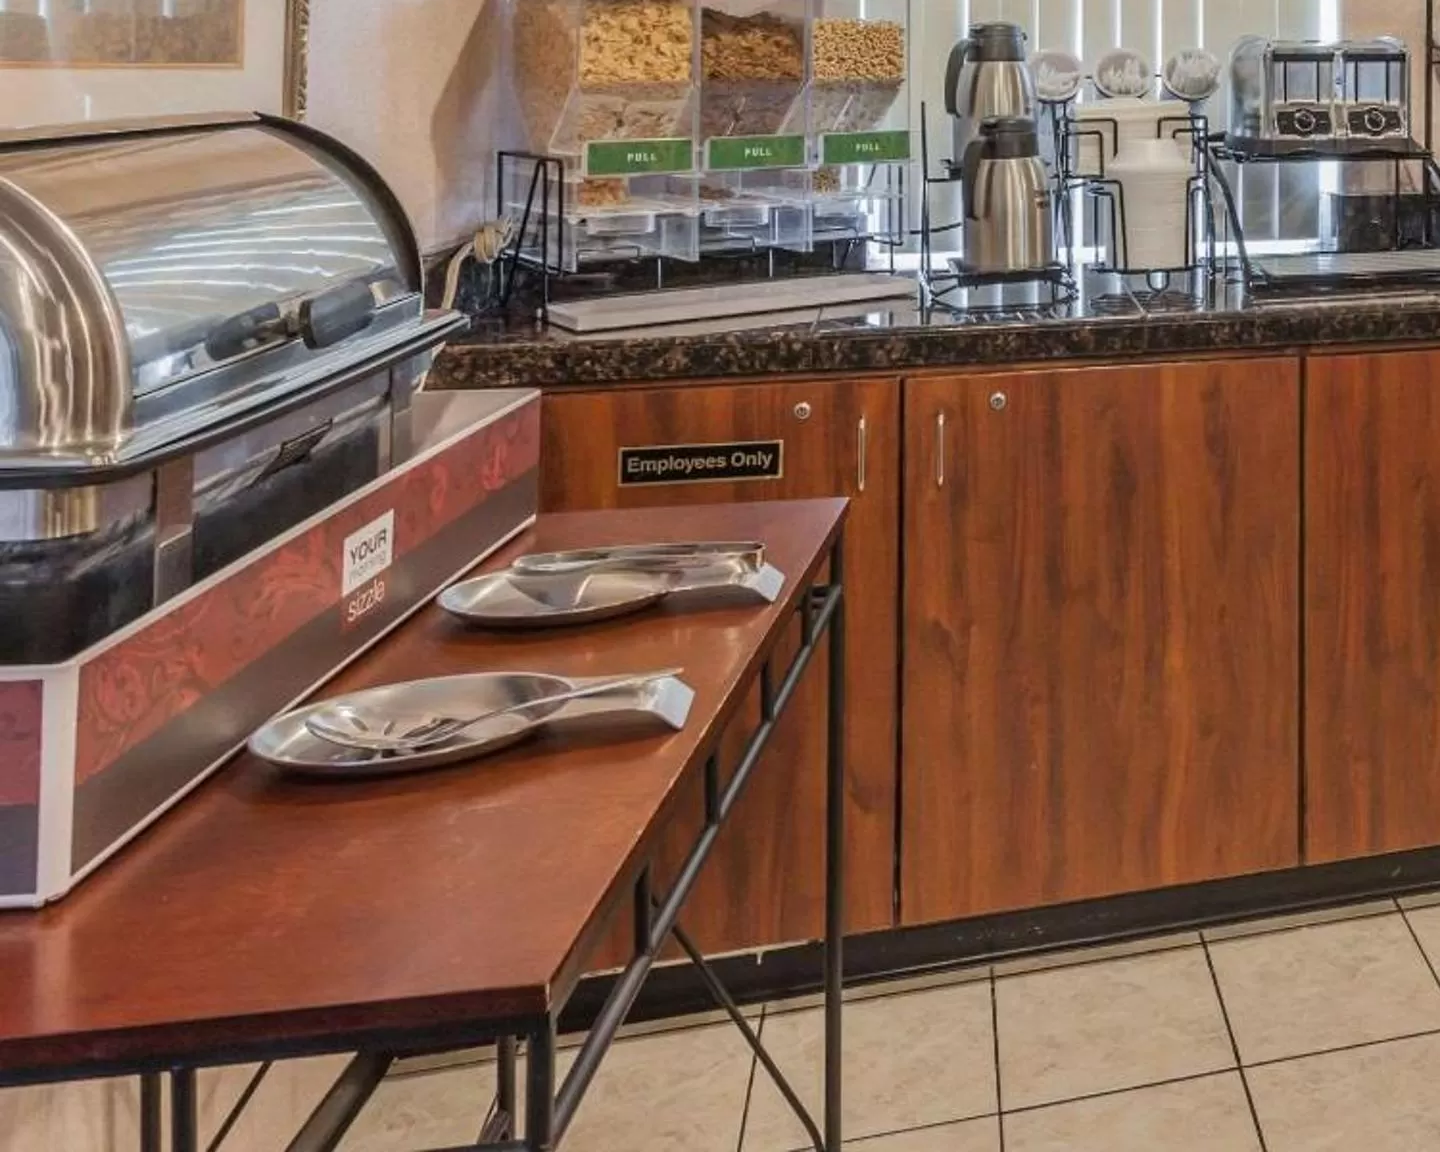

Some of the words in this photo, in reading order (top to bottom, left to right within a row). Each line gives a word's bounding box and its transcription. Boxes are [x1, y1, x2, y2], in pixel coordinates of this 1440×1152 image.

[744, 147, 773, 159] PULL
[855, 142, 880, 153] PULL
[627, 152, 657, 163] PULL
[627, 454, 726, 475] Employees
[730, 450, 773, 469] Only
[350, 528, 387, 565] YOUR
[347, 578, 385, 622] sizzle
